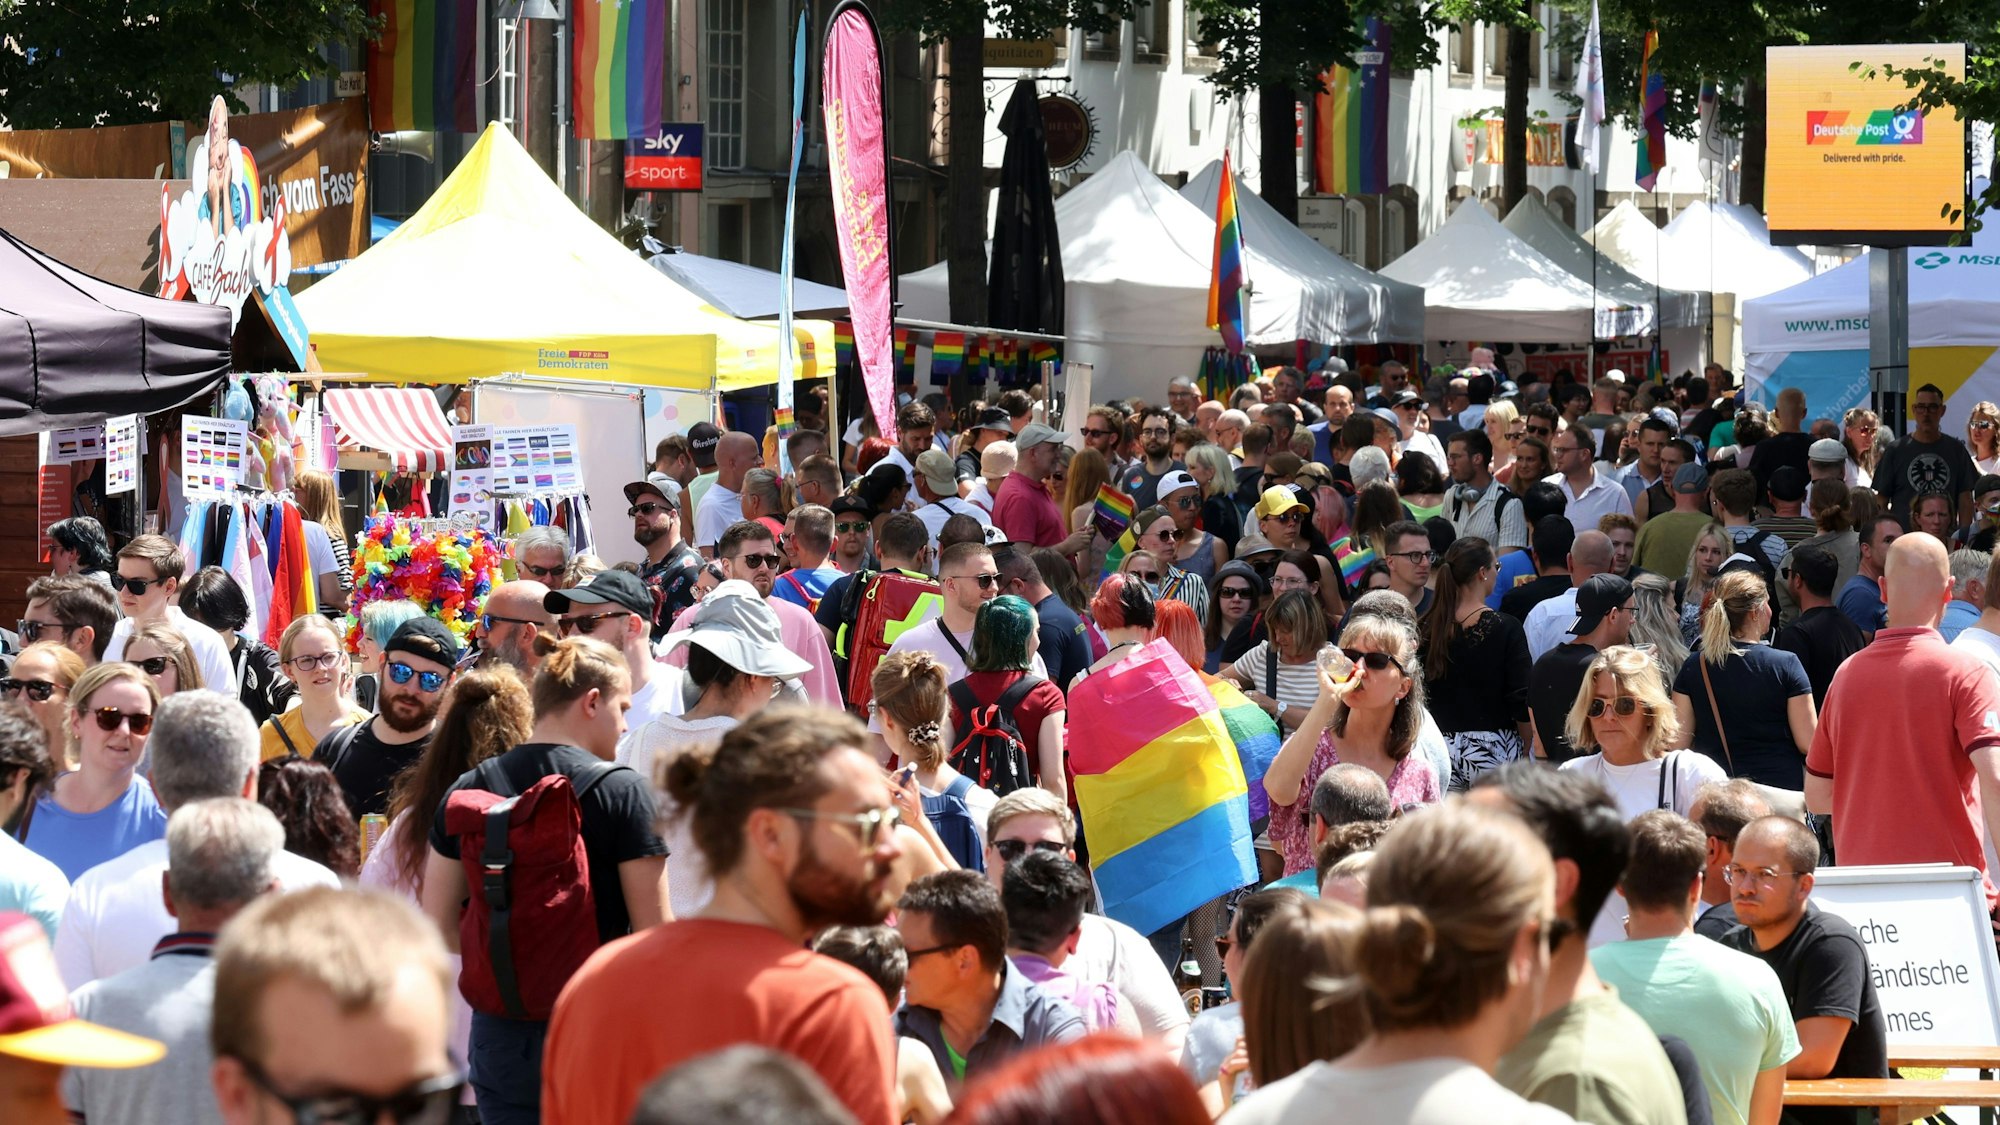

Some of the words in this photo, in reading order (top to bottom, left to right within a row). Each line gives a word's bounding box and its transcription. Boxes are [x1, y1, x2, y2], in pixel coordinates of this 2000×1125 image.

[985, 46, 1044, 59] iquitäten
[1813, 124, 1863, 136] Deutsche
[1865, 124, 1889, 136] Post
[644, 129, 684, 154] sky
[1823, 154, 1861, 163] Delivered
[1863, 154, 1880, 163] with
[1882, 154, 1906, 165] pride.
[640, 166, 687, 182] sport
[261, 174, 279, 217] ch
[283, 177, 319, 214] vom
[320, 165, 355, 207] Fass
[1305, 206, 1320, 216] Zum
[192, 257, 212, 290] CAFÉ
[538, 348, 566, 358] Freie
[538, 359, 609, 370] Demokraten
[1855, 918, 1899, 944] che
[1870, 959, 1969, 989] ändische
[1885, 1010, 1933, 1032] mes
